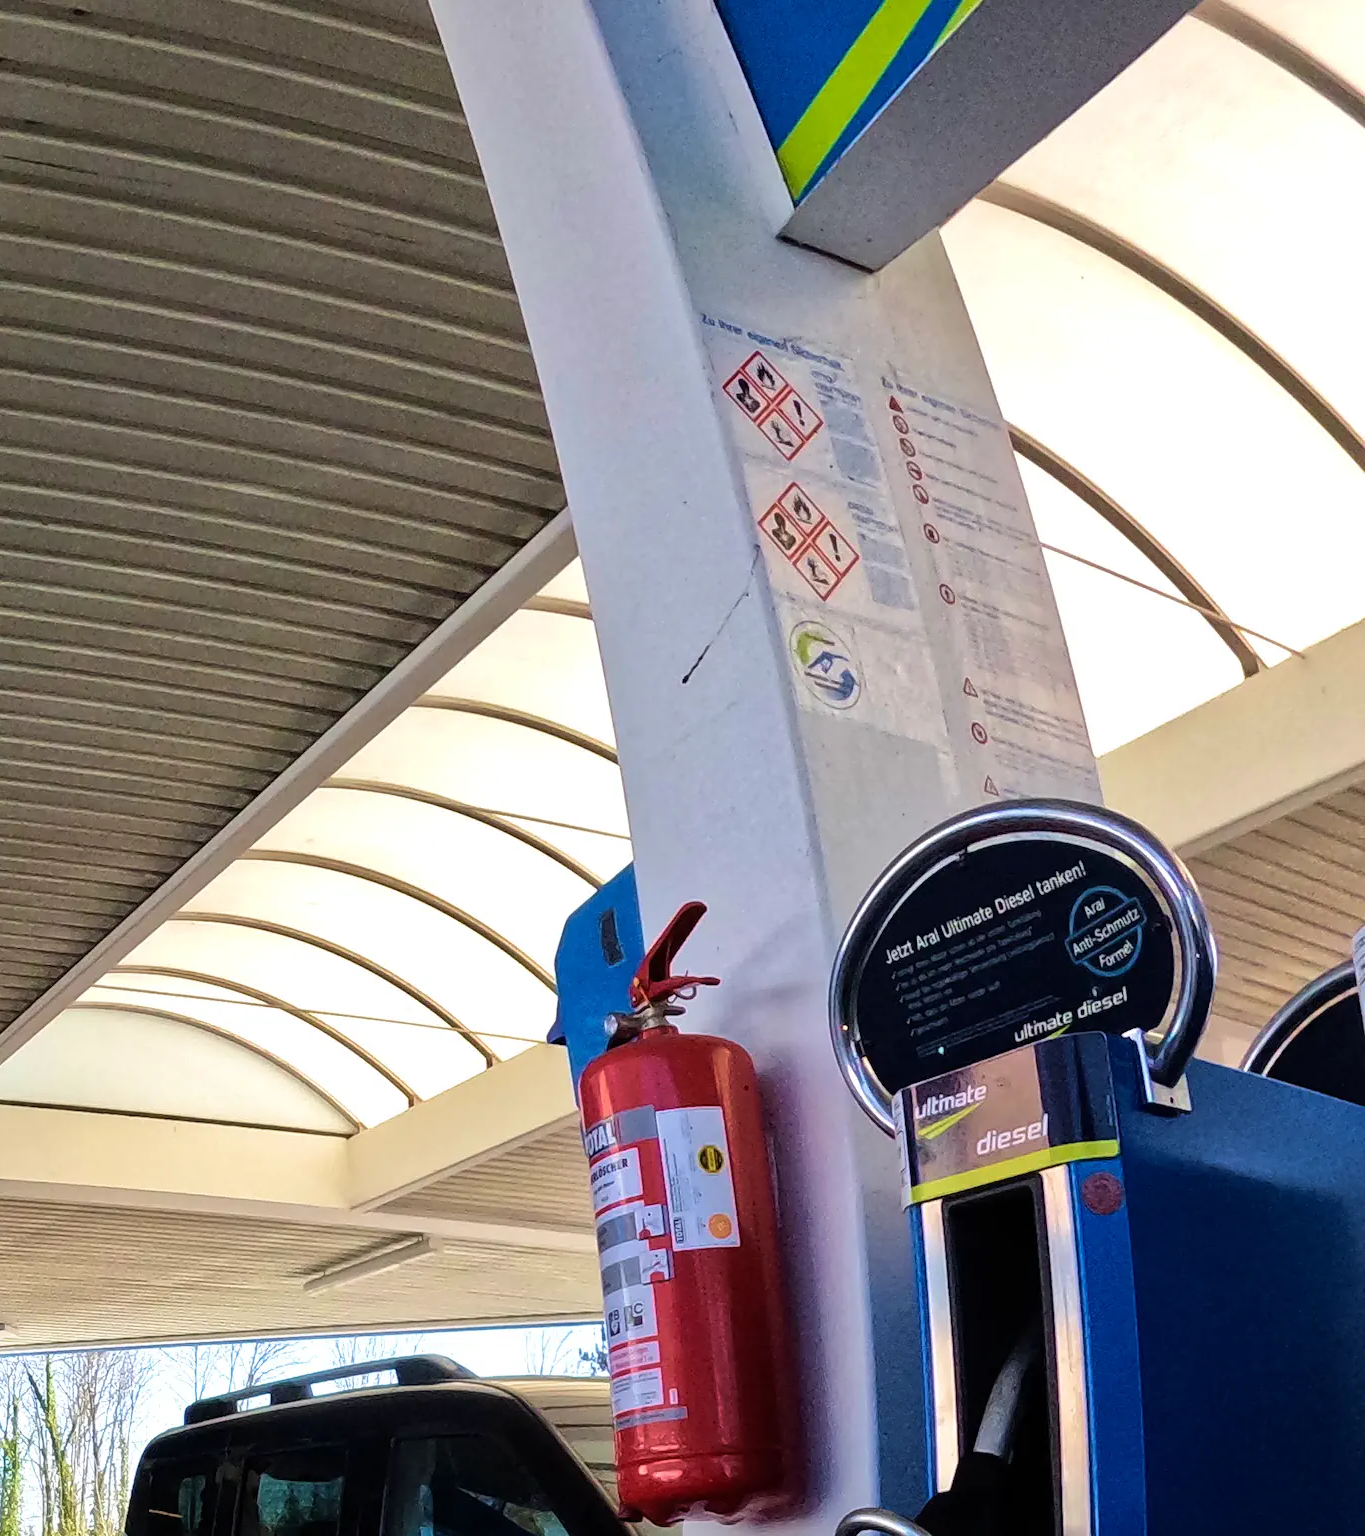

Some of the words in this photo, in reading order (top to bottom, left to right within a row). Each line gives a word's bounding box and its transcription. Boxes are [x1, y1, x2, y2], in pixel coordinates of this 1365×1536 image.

[885, 944, 915, 965] Jetzt
[916, 928, 941, 950] Aral
[942, 906, 995, 939] Ultimate
[994, 885, 1036, 914] Diesel
[1036, 860, 1087, 895] tanken!
[1084, 897, 1106, 918] Aral
[1072, 906, 1142, 956] Anti-Schmutz
[1098, 940, 1134, 969] Formel
[1014, 1008, 1073, 1043] ultimate
[1077, 985, 1129, 1019] diesel
[915, 1084, 988, 1120] ultimate
[585, 1122, 617, 1157] OTAL
[977, 1112, 1049, 1156] diesel
